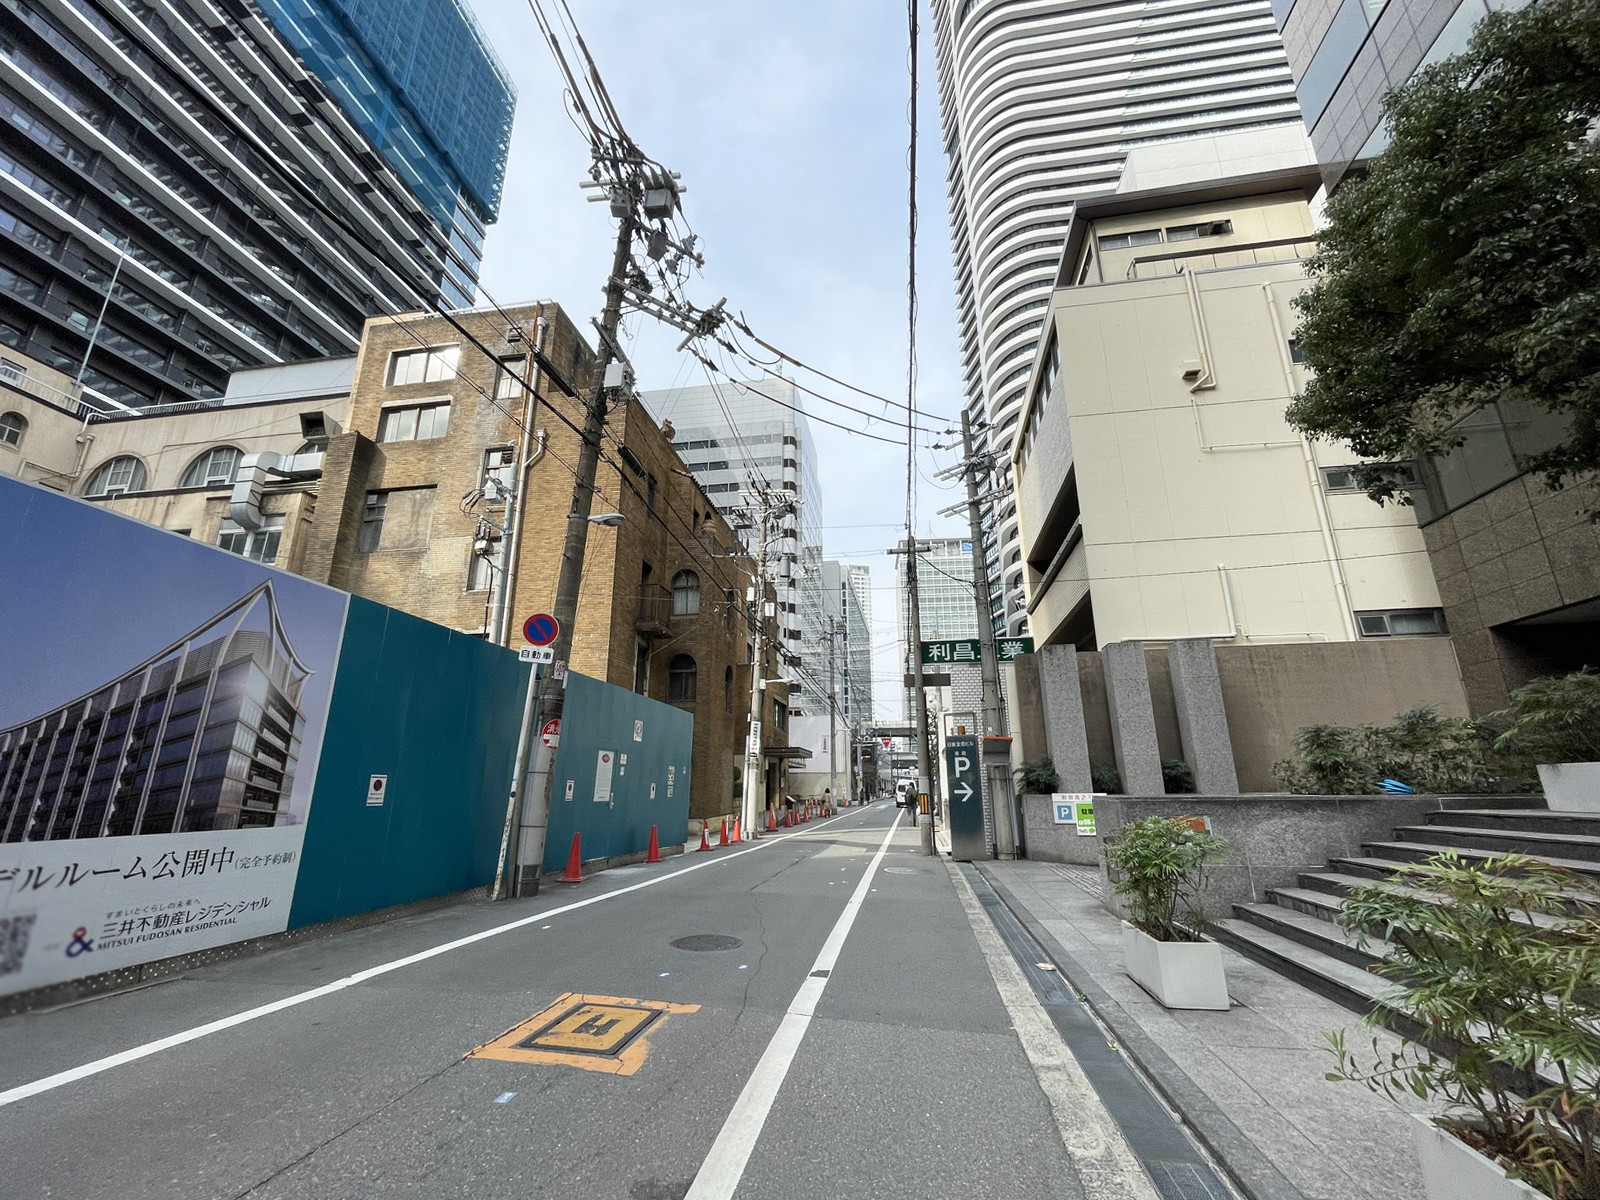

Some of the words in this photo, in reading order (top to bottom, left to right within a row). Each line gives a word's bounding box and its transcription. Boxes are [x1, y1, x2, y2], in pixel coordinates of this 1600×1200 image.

[521, 650, 551, 660] 自動車
[928, 642, 1025, 661] 利昌業
[954, 757, 970, 778] P
[1061, 807, 1069, 818] P
[235, 851, 297, 870] (完全予約制)
[100, 896, 272, 939] 三井不動産レジデンシャル
[105, 898, 201, 920] すまいとくらしの未来へ
[97, 936, 134, 951] MITSUI
[136, 927, 183, 944] FUDOSAN
[184, 917, 238, 934] RESIDENTIAL
